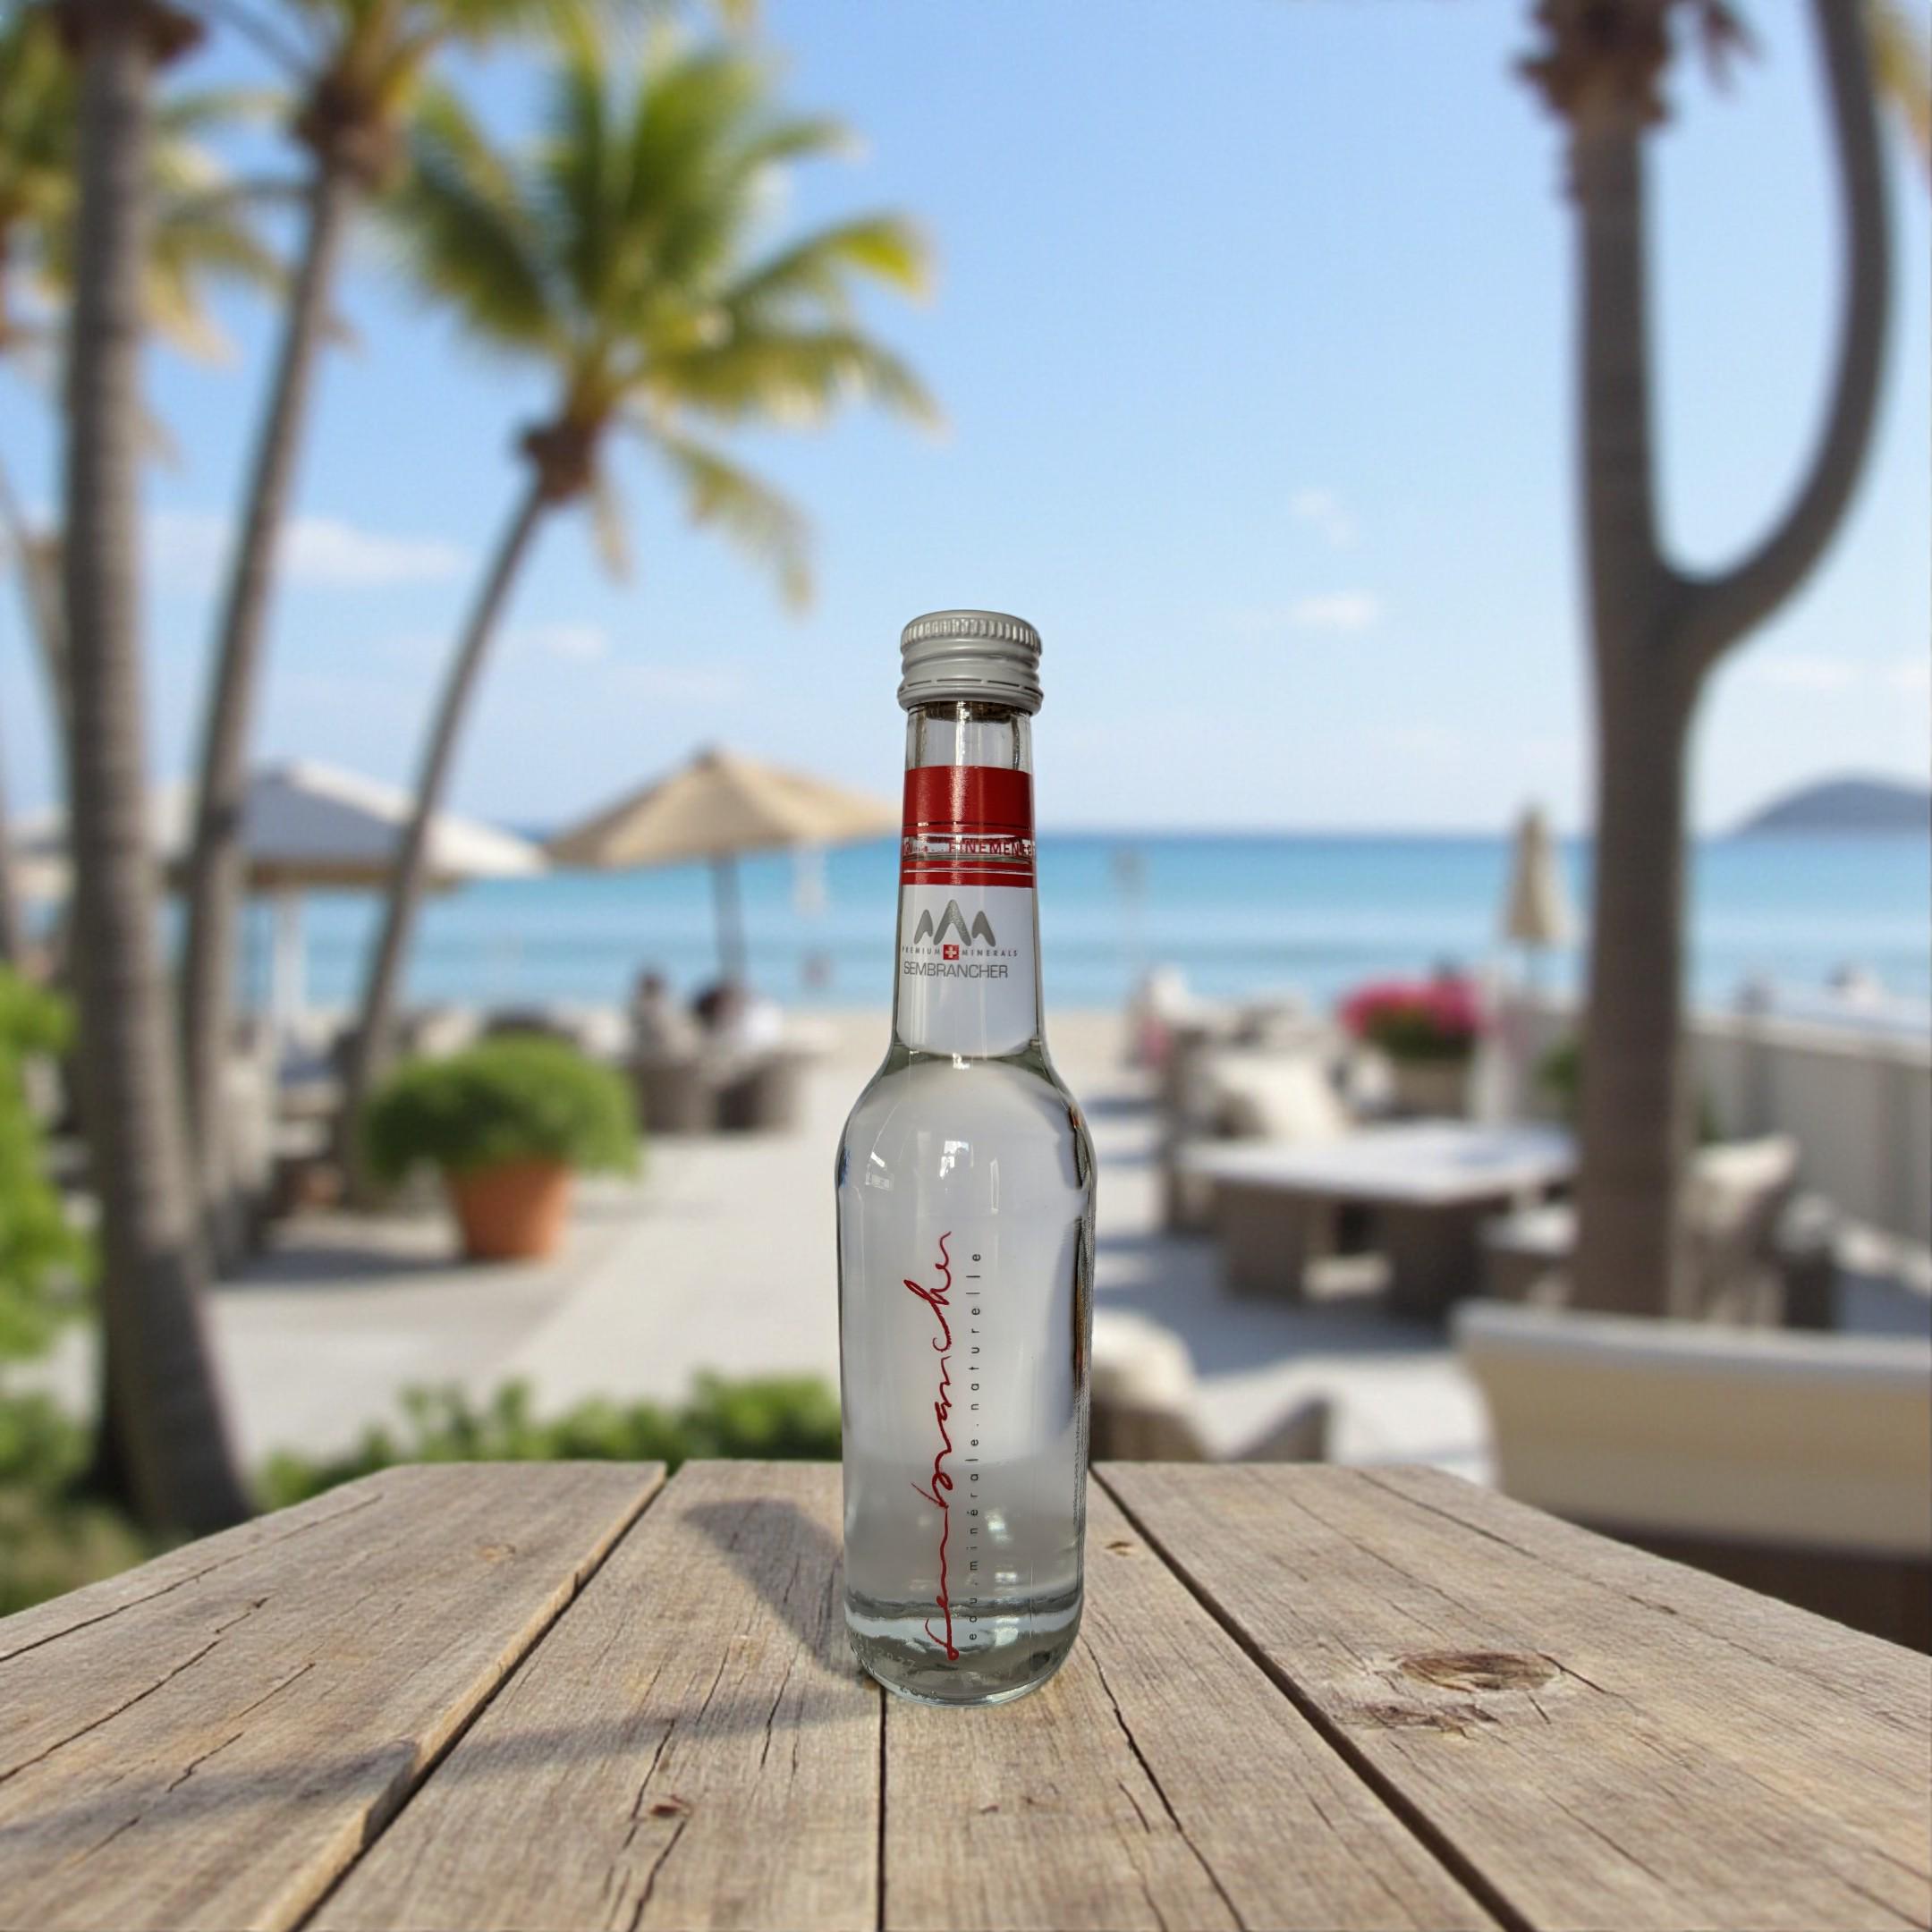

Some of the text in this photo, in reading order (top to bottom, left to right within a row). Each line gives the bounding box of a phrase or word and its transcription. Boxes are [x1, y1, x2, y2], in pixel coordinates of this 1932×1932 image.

[902, 945, 1018, 958] PREMIUM MINERALS
[903, 961, 1009, 979] SEMBRANCHER
